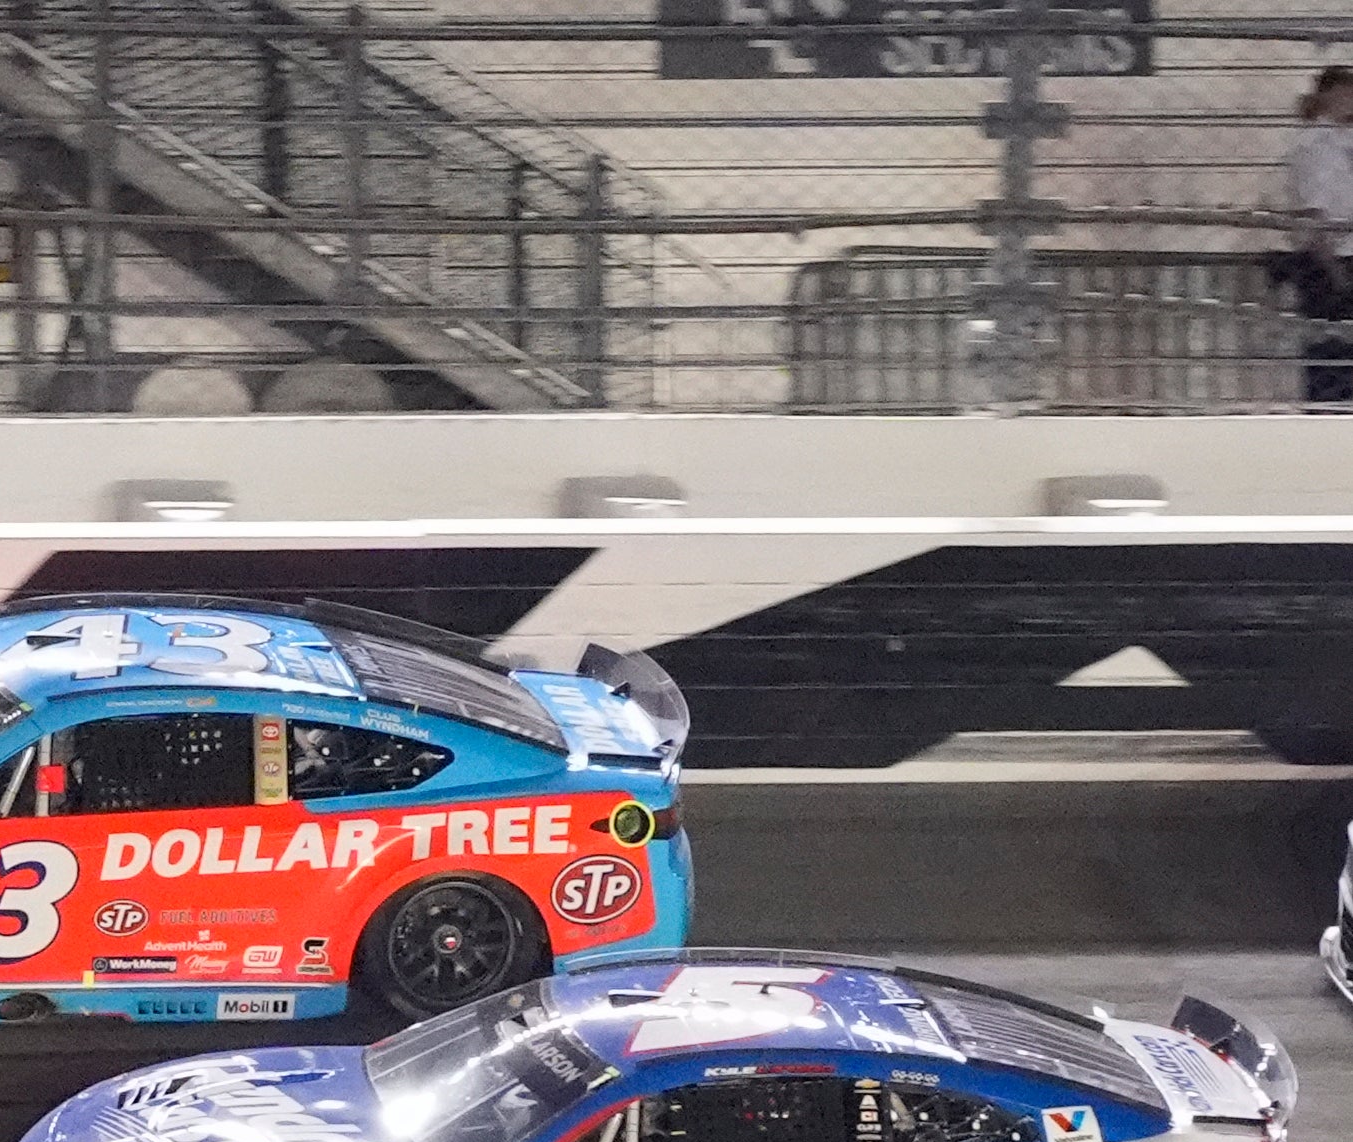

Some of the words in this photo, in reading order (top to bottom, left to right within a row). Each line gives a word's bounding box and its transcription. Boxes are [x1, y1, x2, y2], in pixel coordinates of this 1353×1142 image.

[366, 708, 403, 724] CLUB
[360, 715, 431, 741] WYNDHAM
[101, 817, 381, 881] DOLLAR
[400, 804, 572, 862] TREE
[561, 864, 632, 915] STP
[97, 903, 144, 933] STP
[160, 910, 193, 924] FUEL
[200, 908, 278, 924] ADDITIVES
[144, 940, 227, 952] AdventHealth
[109, 957, 178, 972] WorkMoney
[223, 999, 270, 1015] Mobil
[272, 1000, 289, 1014] 1
[622, 965, 835, 1057] 5
[528, 1034, 584, 1084] LARSON
[703, 1065, 757, 1077] KYLE
